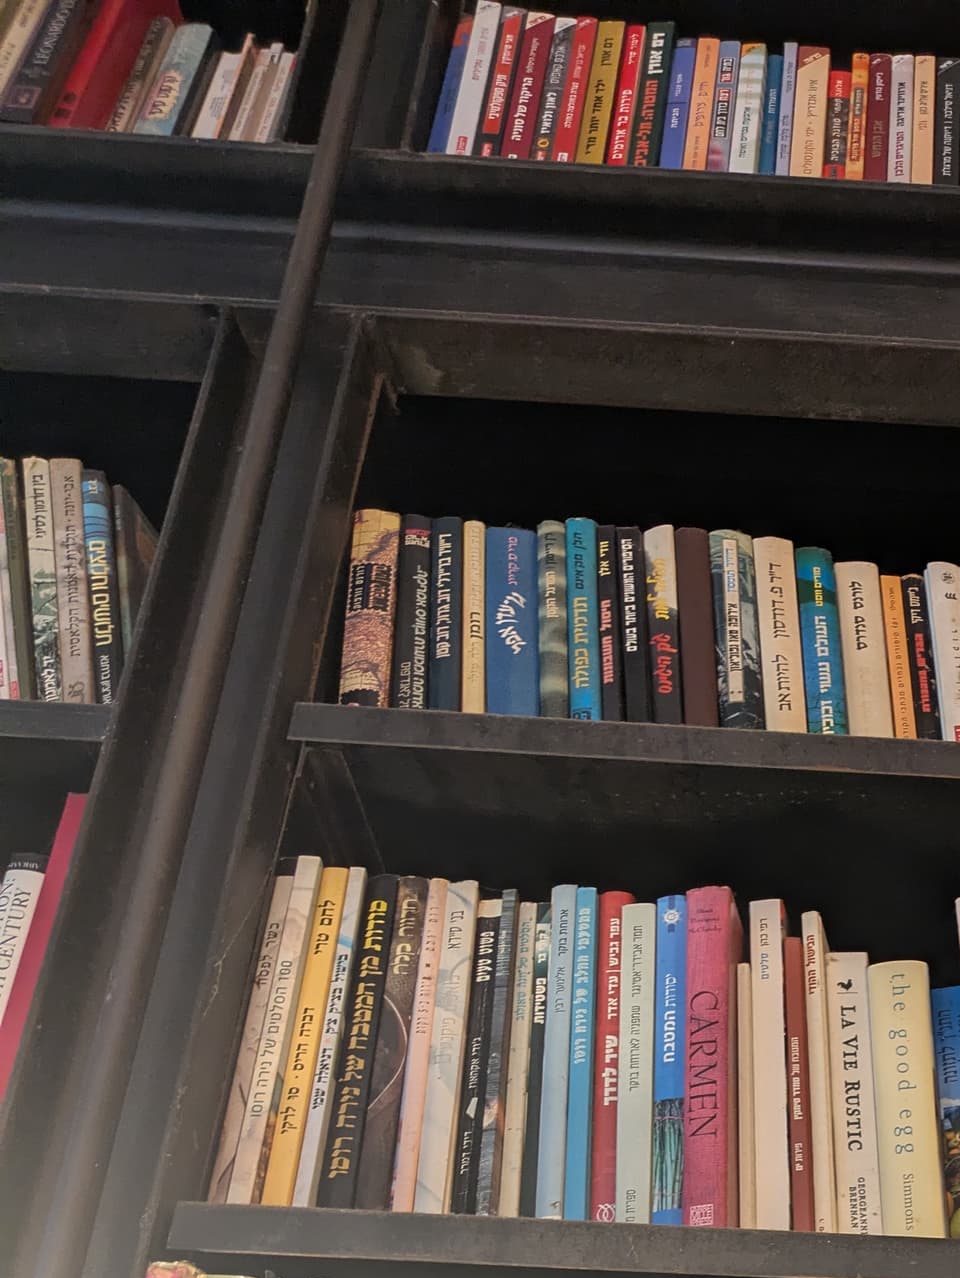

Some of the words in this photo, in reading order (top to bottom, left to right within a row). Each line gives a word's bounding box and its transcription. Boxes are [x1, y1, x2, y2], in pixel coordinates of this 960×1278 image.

[648, 50, 663, 74] אורן
[849, 581, 864, 609] לורנס
[854, 615, 869, 651] סנדרס
[772, 654, 790, 692] להיות
[779, 694, 792, 712] אב
[320, 899, 336, 926] לחם
[364, 899, 389, 951] סודות
[313, 930, 329, 956] טרי
[360, 955, 384, 978] מן
[664, 974, 679, 1012] יסודות
[891, 973, 908, 1011] the
[349, 982, 375, 1051] המטבח
[840, 1005, 857, 1029] LA
[605, 1035, 619, 1062] שיר
[663, 1013, 677, 1064] המטבח
[842, 1035, 858, 1071] VIE
[338, 1055, 366, 1083] של
[688, 990, 720, 1139] CARMEN
[888, 1028, 918, 1092] good
[602, 1065, 618, 1106] לדרך
[335, 1086, 357, 1128] נירה
[844, 1080, 861, 1151] RUSTIC
[893, 1107, 915, 1155] egg
[328, 1135, 353, 1179] רוסו
[849, 1186, 858, 1228] BRENNAN
[902, 1172, 915, 1231] Simmons
